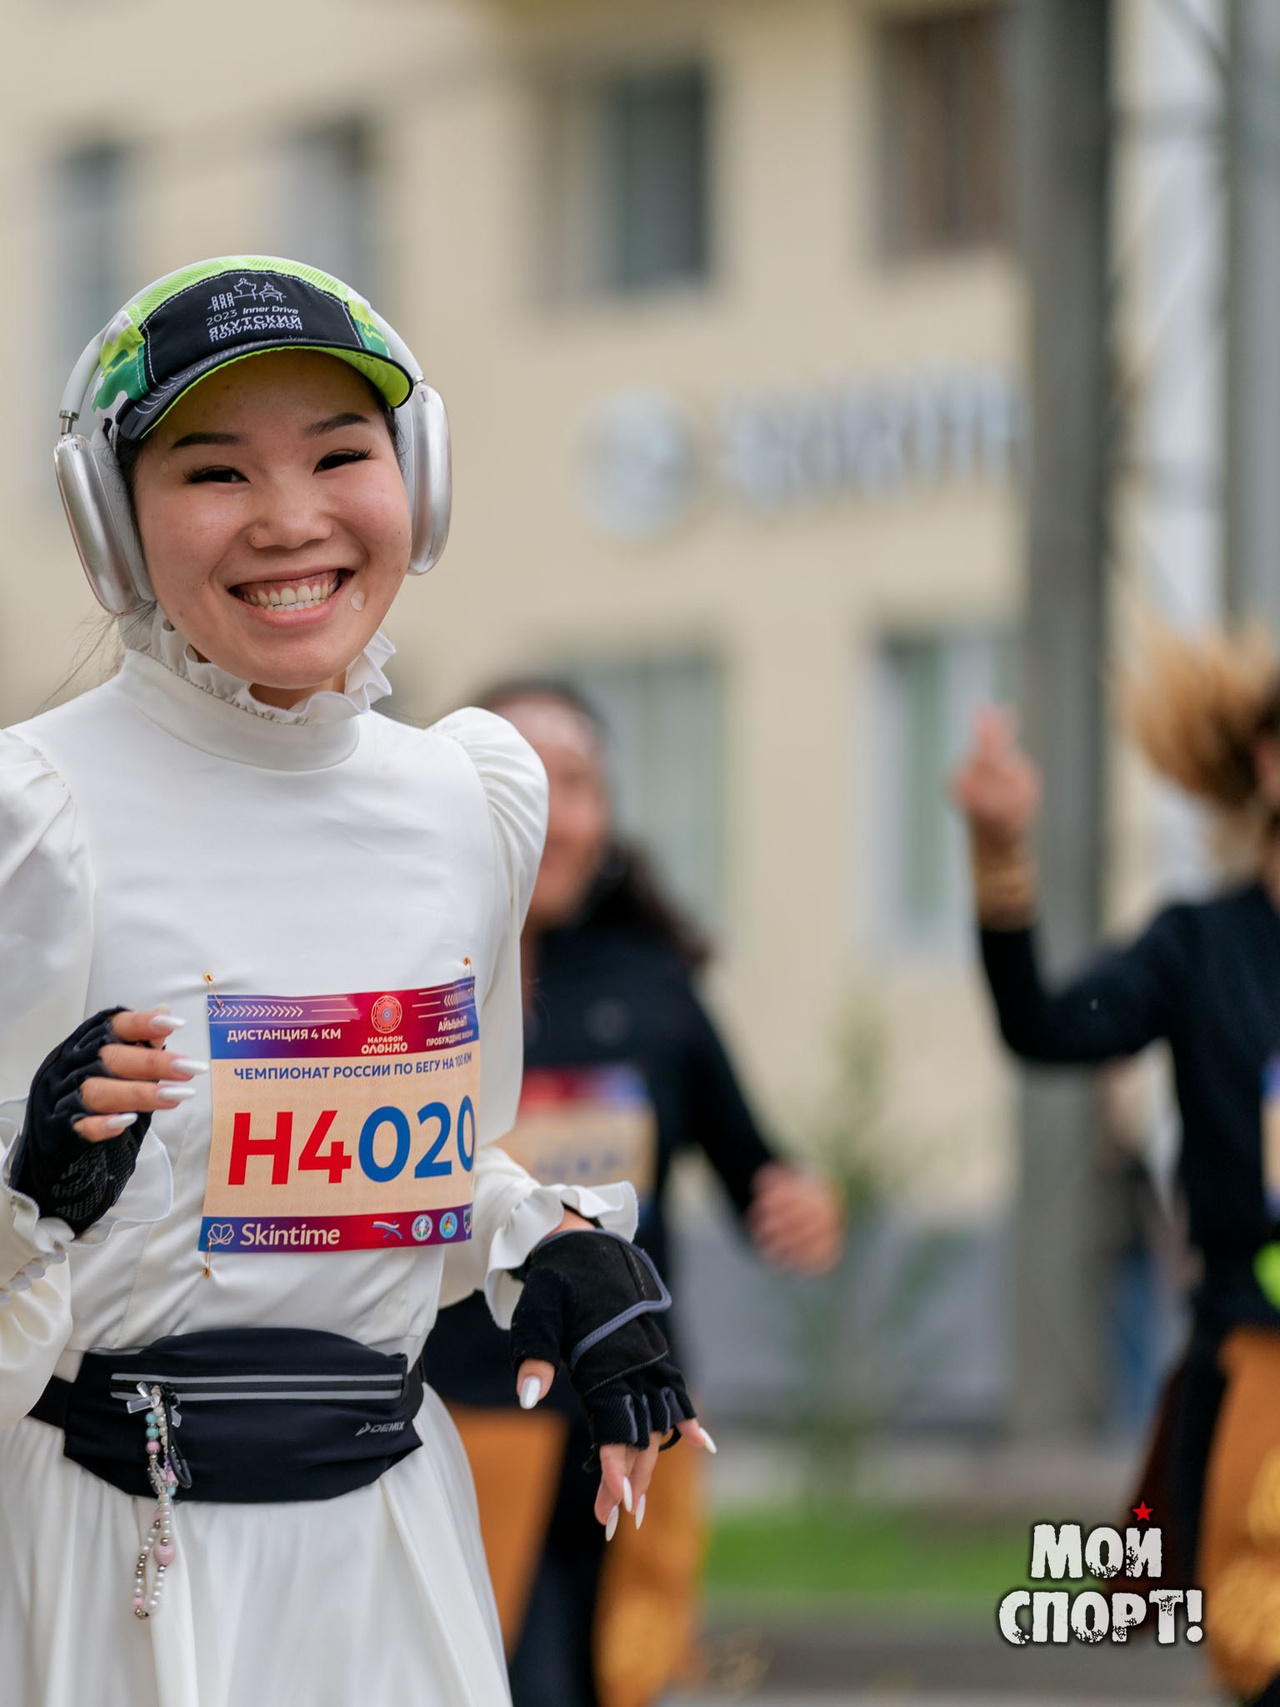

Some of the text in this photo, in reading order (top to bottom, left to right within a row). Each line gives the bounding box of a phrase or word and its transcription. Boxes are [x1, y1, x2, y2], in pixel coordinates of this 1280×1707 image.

[206, 305, 299, 327] 2023 Inner Drive
[208, 314, 302, 338] ЯКУТСКИЙ
[210, 321, 303, 343] ПОЛУМАРАФОН
[227, 1028, 342, 1043] ДИСТАНЦИЯ 4 КМ
[367, 1035, 403, 1044] МАРАФОН
[234, 1066, 330, 1081] ЧЕМПИОНАТ
[333, 1063, 391, 1079] РОССИИ
[394, 1063, 413, 1076] ПО
[416, 1059, 441, 1074] БЕГУ
[442, 1057, 454, 1070] НА
[239, 1222, 341, 1246] Skintime
[369, 1421, 405, 1433] DEMIX
